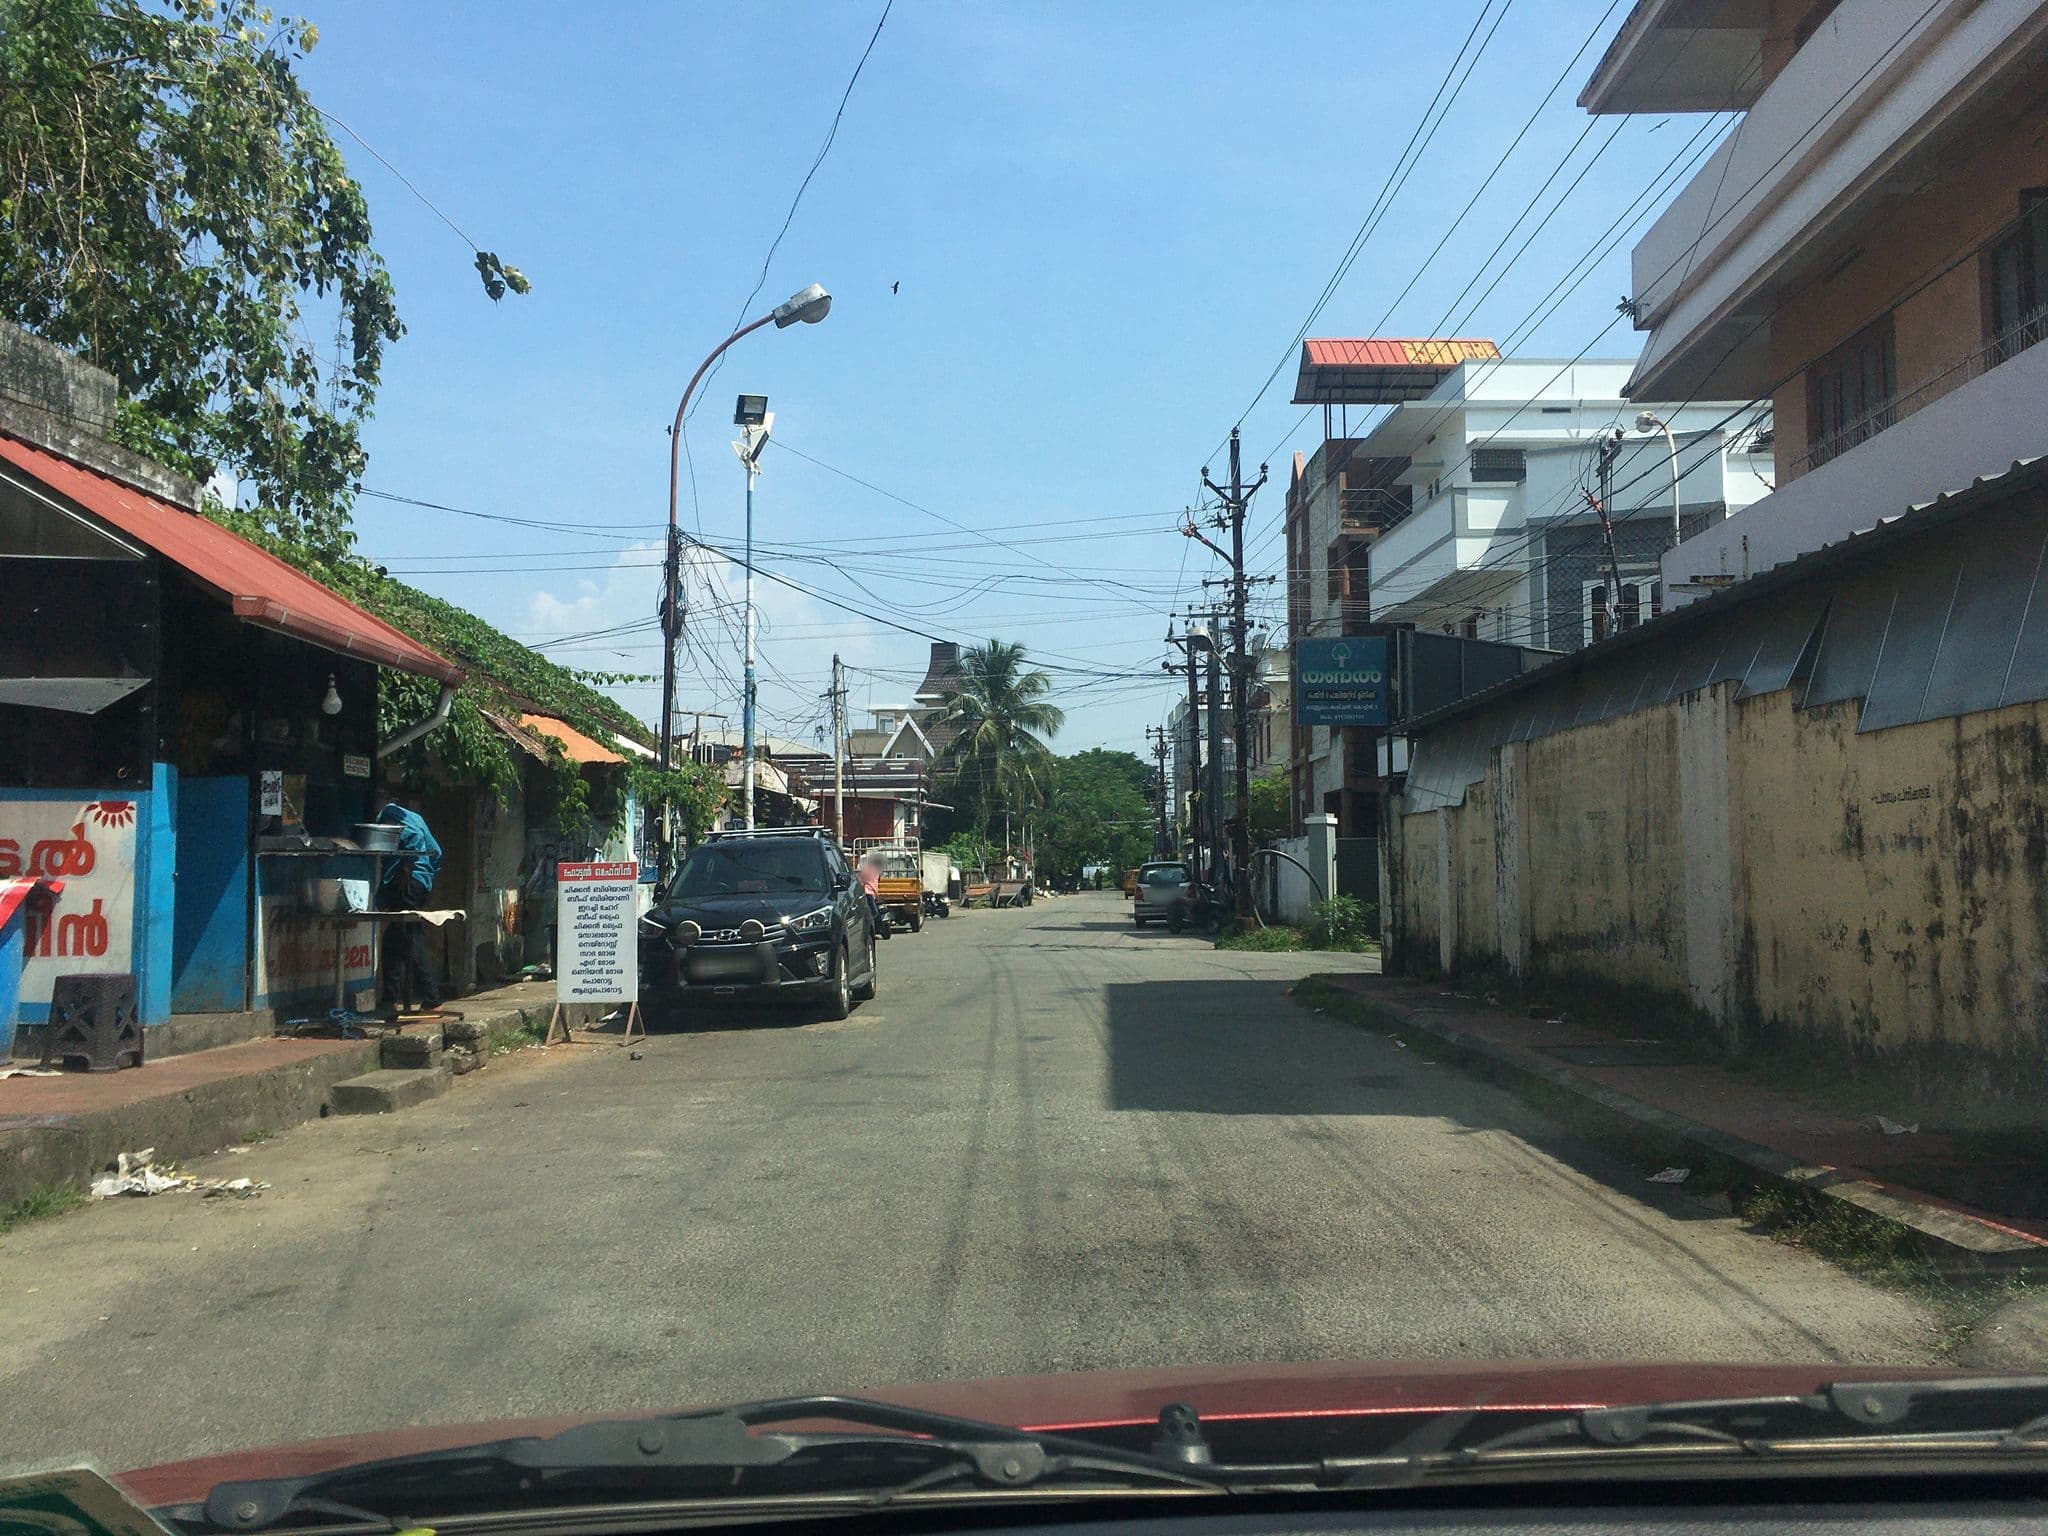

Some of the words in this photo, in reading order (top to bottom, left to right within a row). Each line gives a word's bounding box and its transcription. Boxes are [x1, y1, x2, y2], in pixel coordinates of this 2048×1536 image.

[564, 885, 591, 894] ചിക്കൻ
[593, 884, 634, 894] ബിരിയാണി
[567, 894, 588, 903] ബീഫ്
[590, 893, 630, 903] ബിരിയാണി
[578, 903, 599, 913] ഇറച്ചി
[600, 903, 620, 912] ചോറ്
[577, 912, 597, 921] ബീഫ്
[573, 922, 600, 930] ചിക്കൻ
